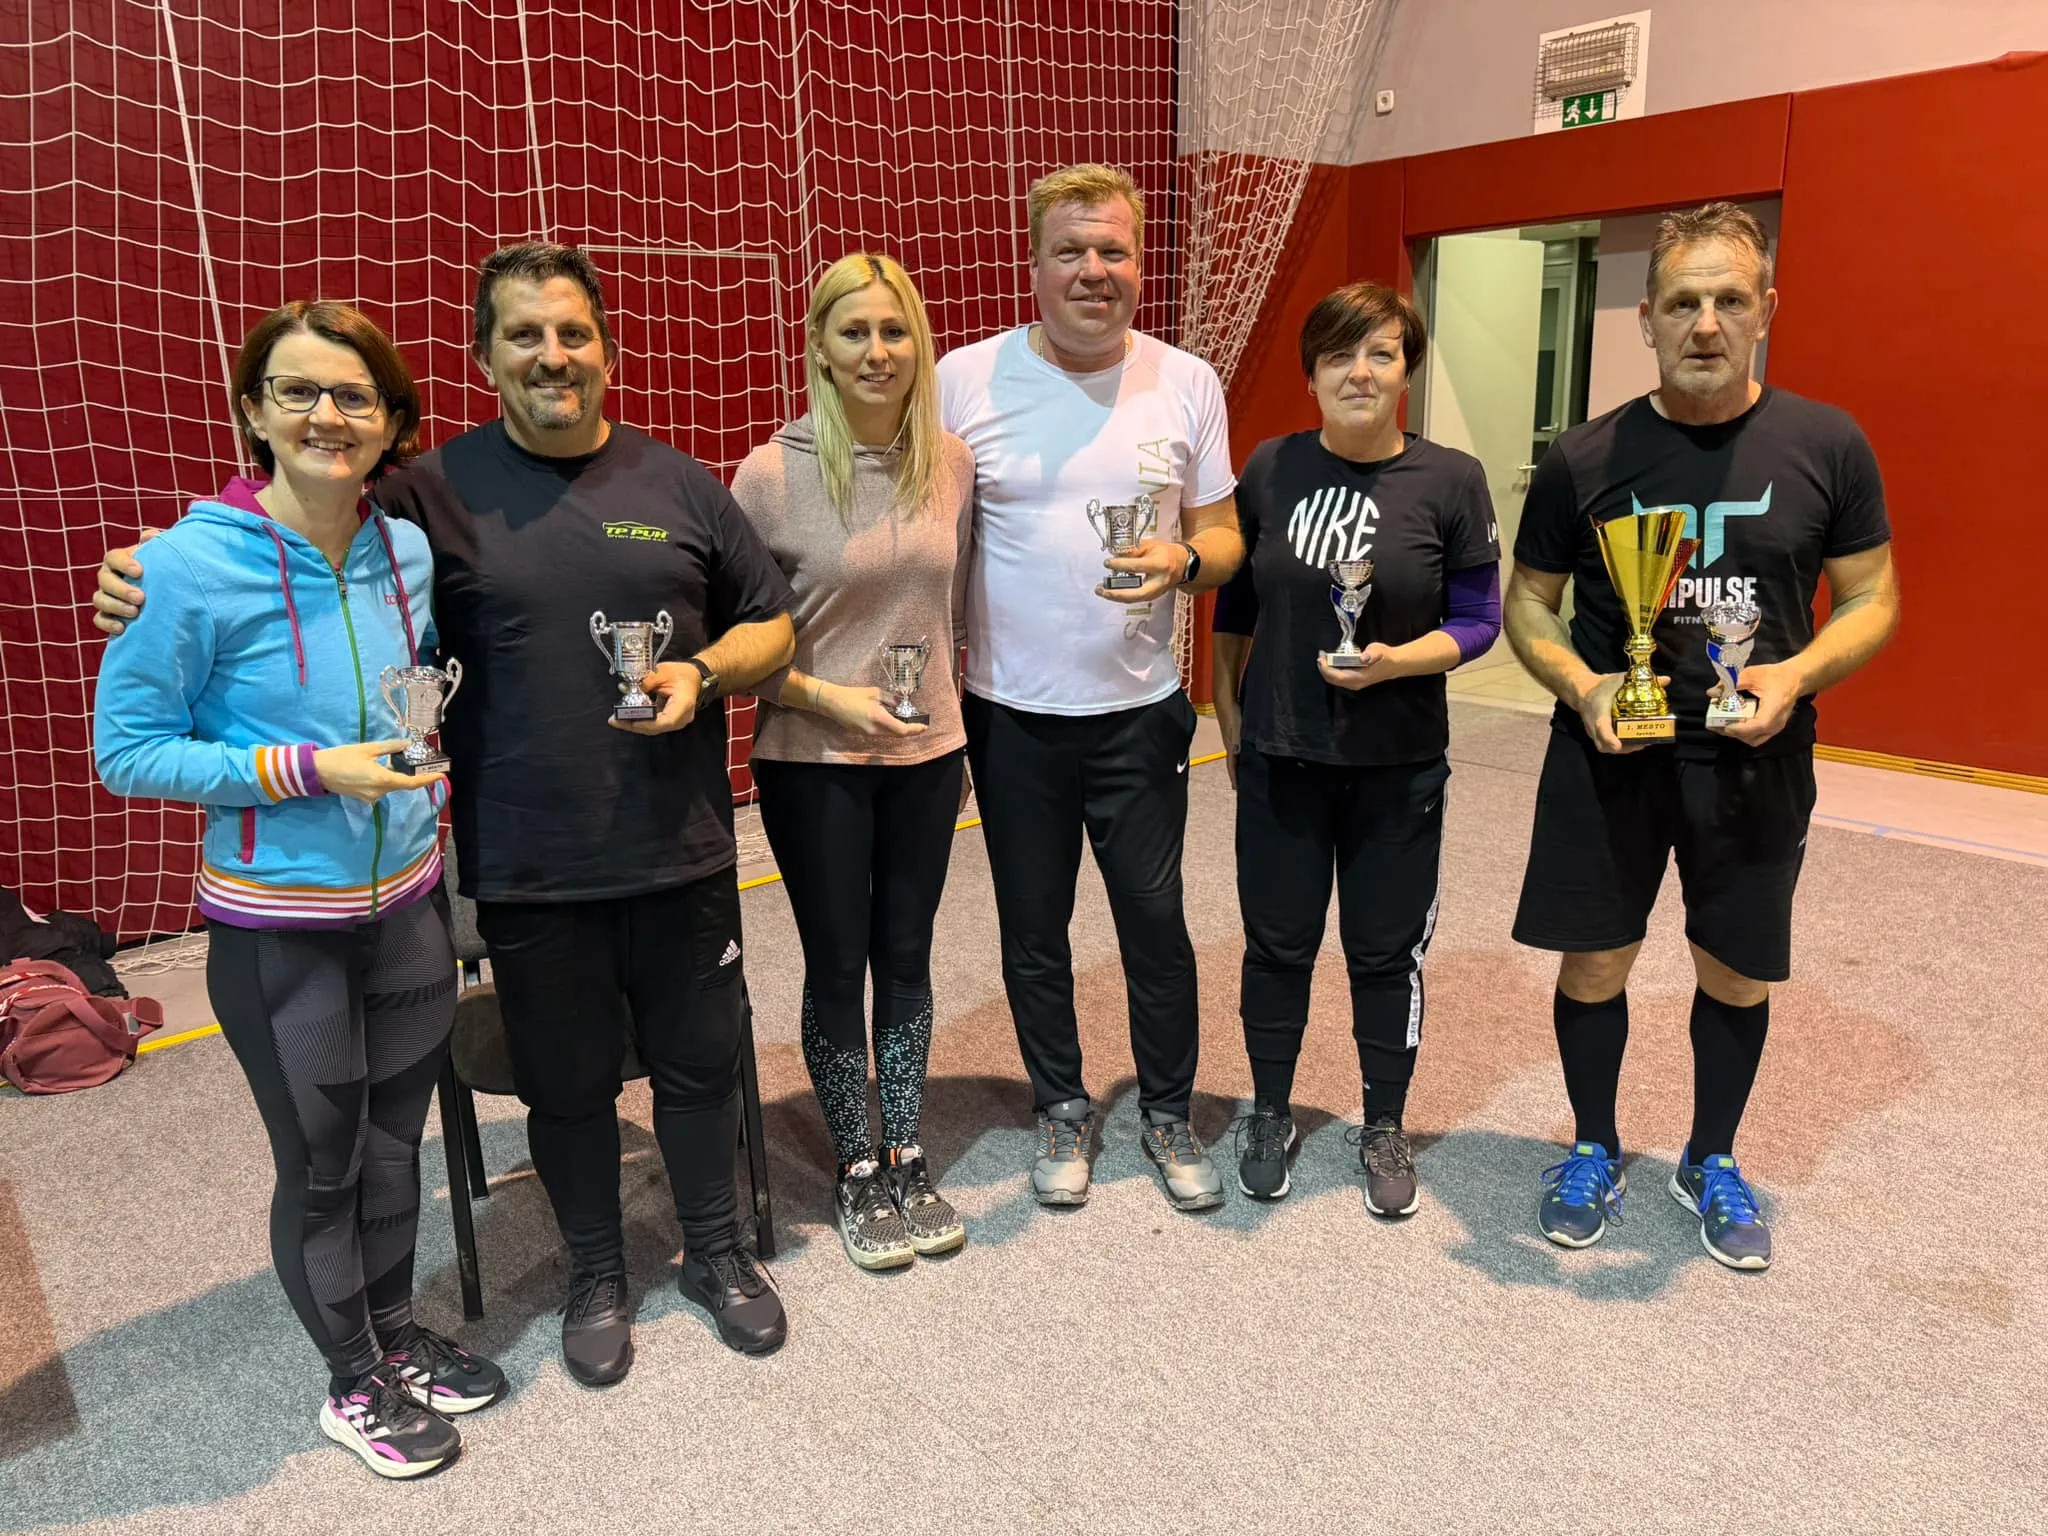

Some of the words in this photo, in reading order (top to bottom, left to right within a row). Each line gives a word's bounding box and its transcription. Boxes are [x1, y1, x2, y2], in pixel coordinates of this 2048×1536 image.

[607, 527, 629, 535] TP
[1124, 437, 1169, 641] SLENIA
[1288, 486, 1380, 568] NIKE
[1664, 576, 1758, 609] PULSE
